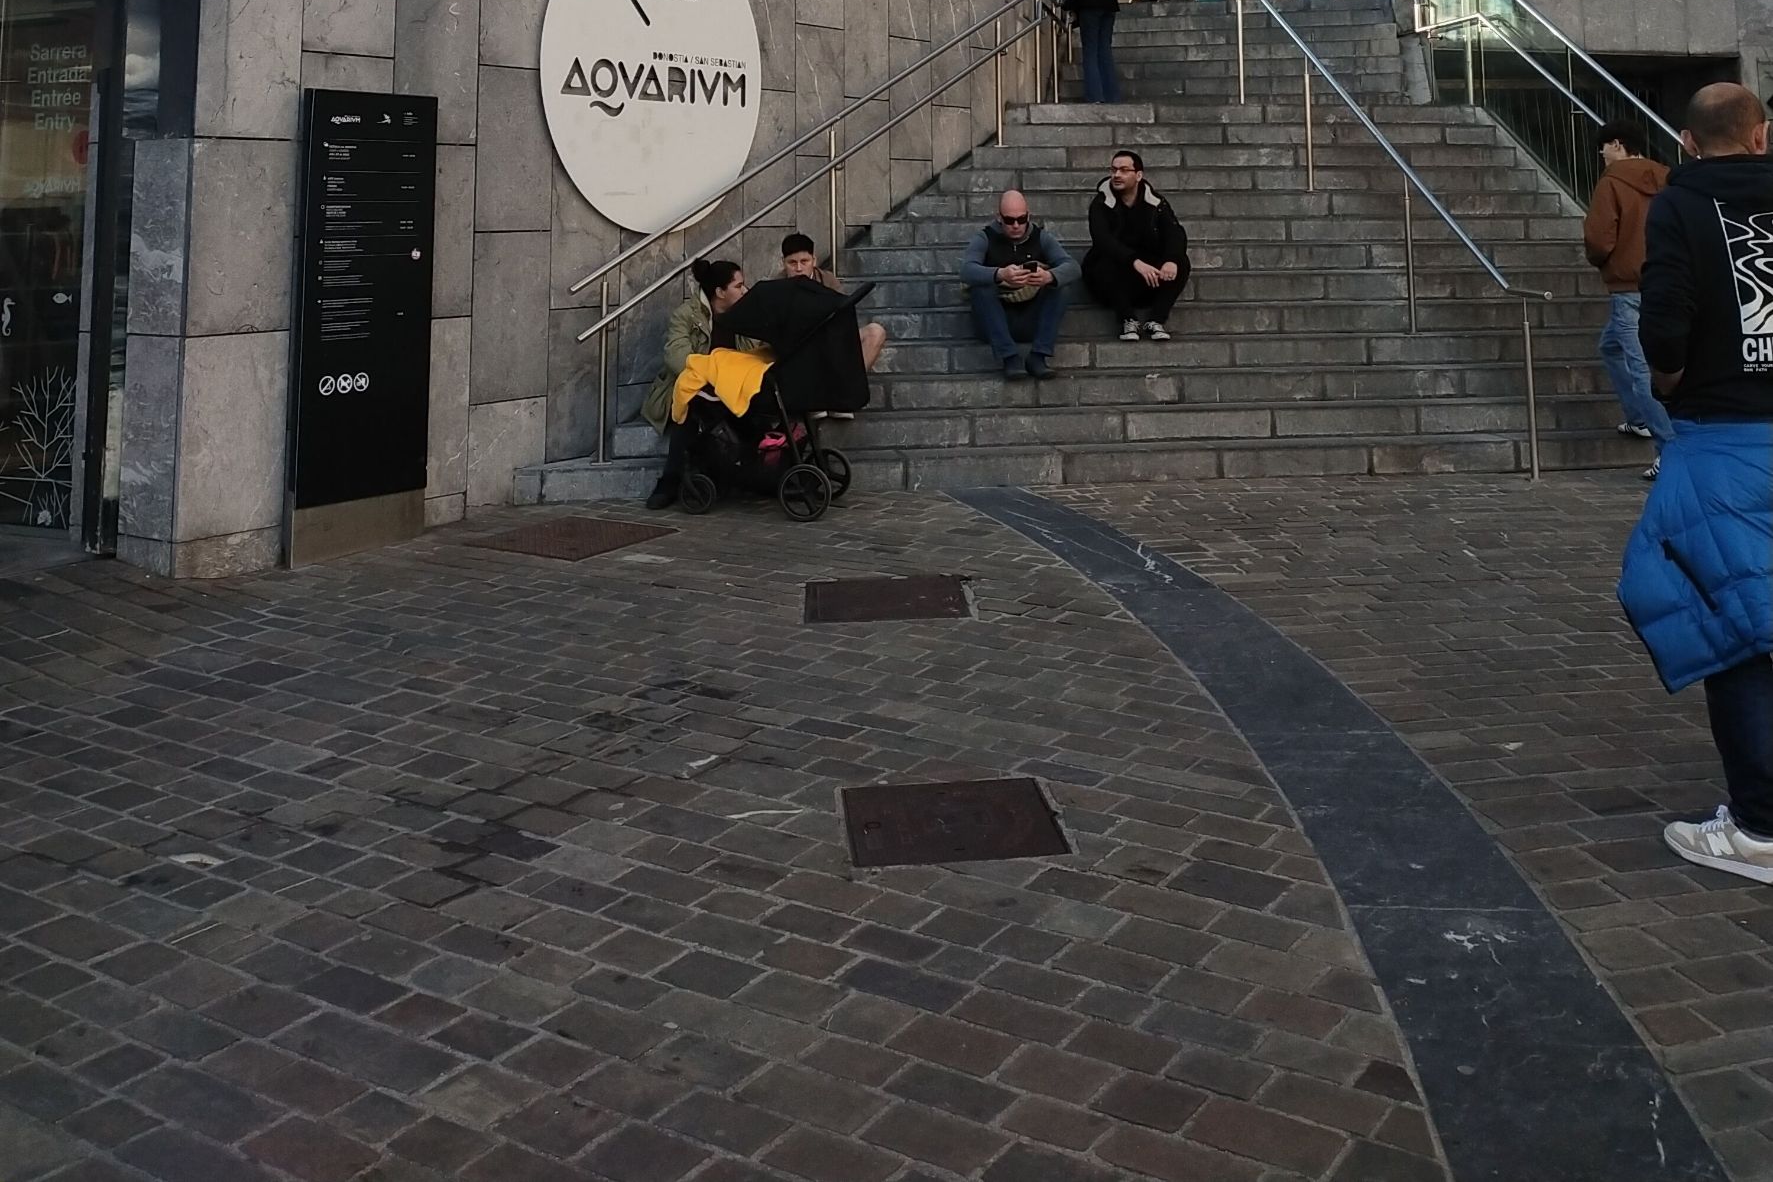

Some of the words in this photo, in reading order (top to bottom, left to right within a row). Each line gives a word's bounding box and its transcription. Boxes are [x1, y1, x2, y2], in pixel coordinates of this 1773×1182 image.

[30, 44, 87, 61] Sarrera
[652, 52, 689, 63] DONOSTIA
[694, 55, 709, 66] SAN
[710, 57, 746, 70] SEBASTIAN
[27, 68, 88, 84] Entrada
[31, 88, 81, 107] Entrée
[34, 113, 76, 133] Entry
[1742, 337, 1773, 362] CH
